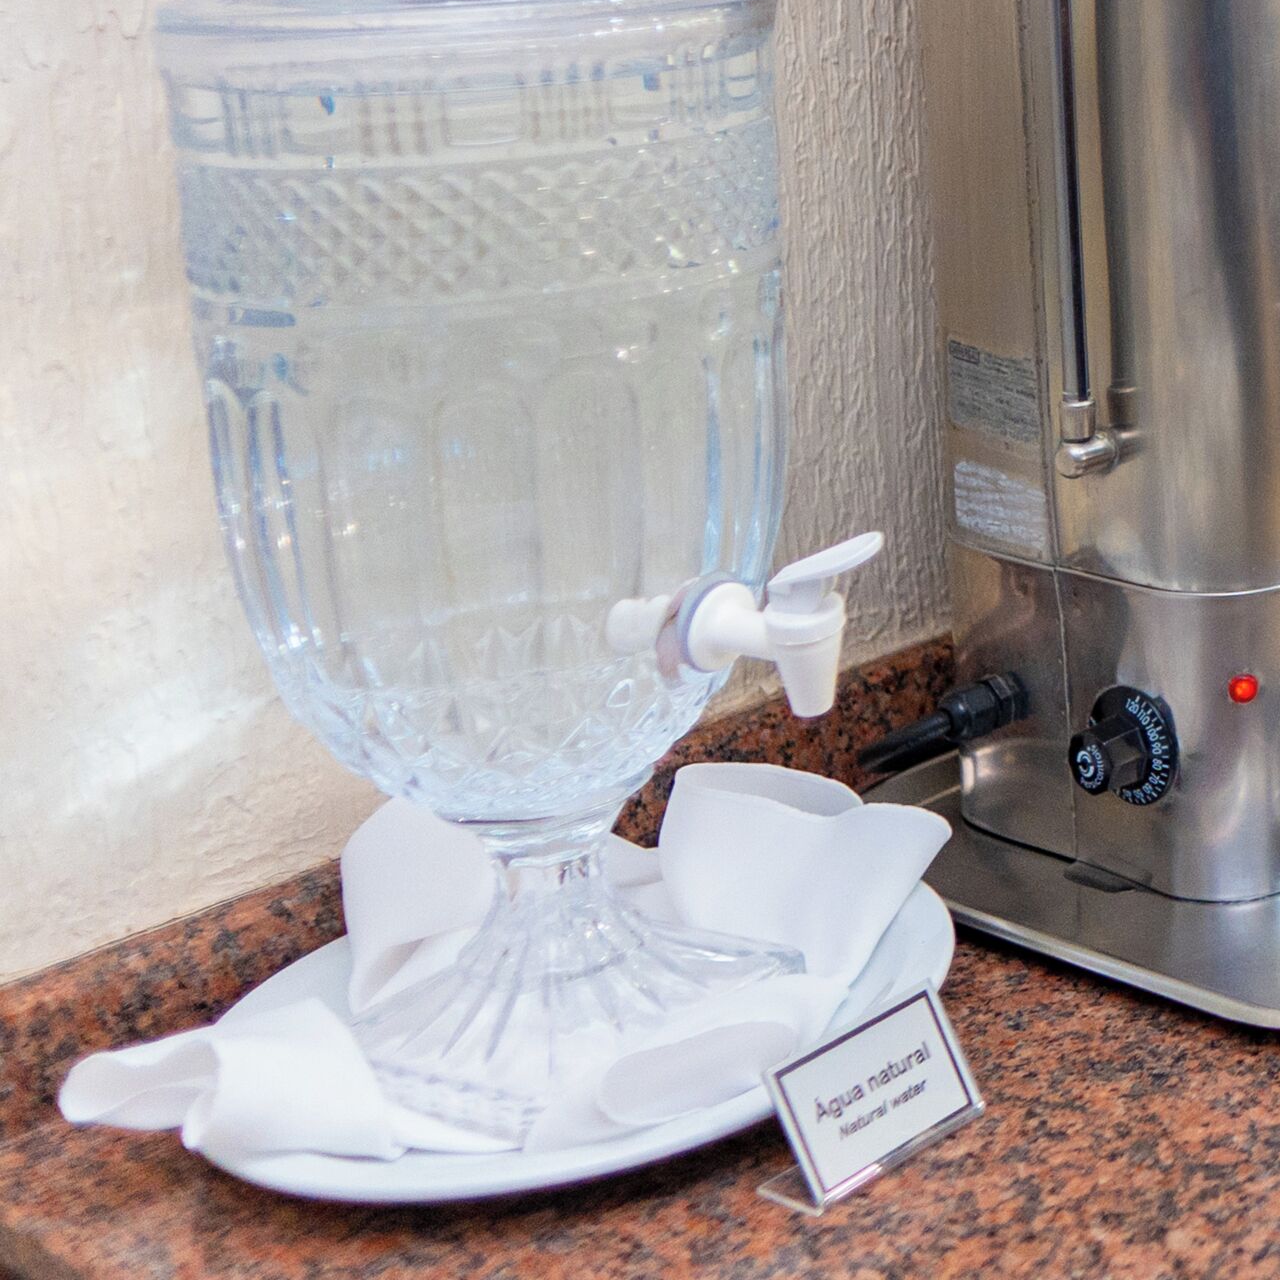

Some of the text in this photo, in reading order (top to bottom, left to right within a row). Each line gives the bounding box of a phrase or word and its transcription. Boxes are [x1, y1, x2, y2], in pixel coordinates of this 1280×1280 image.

[1125, 698, 1139, 715] 120
[1137, 709, 1149, 726] 110
[1145, 723, 1158, 741] 100
[1151, 742, 1162, 755] 90
[1151, 758, 1162, 771] 80
[1148, 772, 1160, 784] 70
[867, 1042, 931, 1092] natural
[839, 1078, 927, 1140] Natural water
